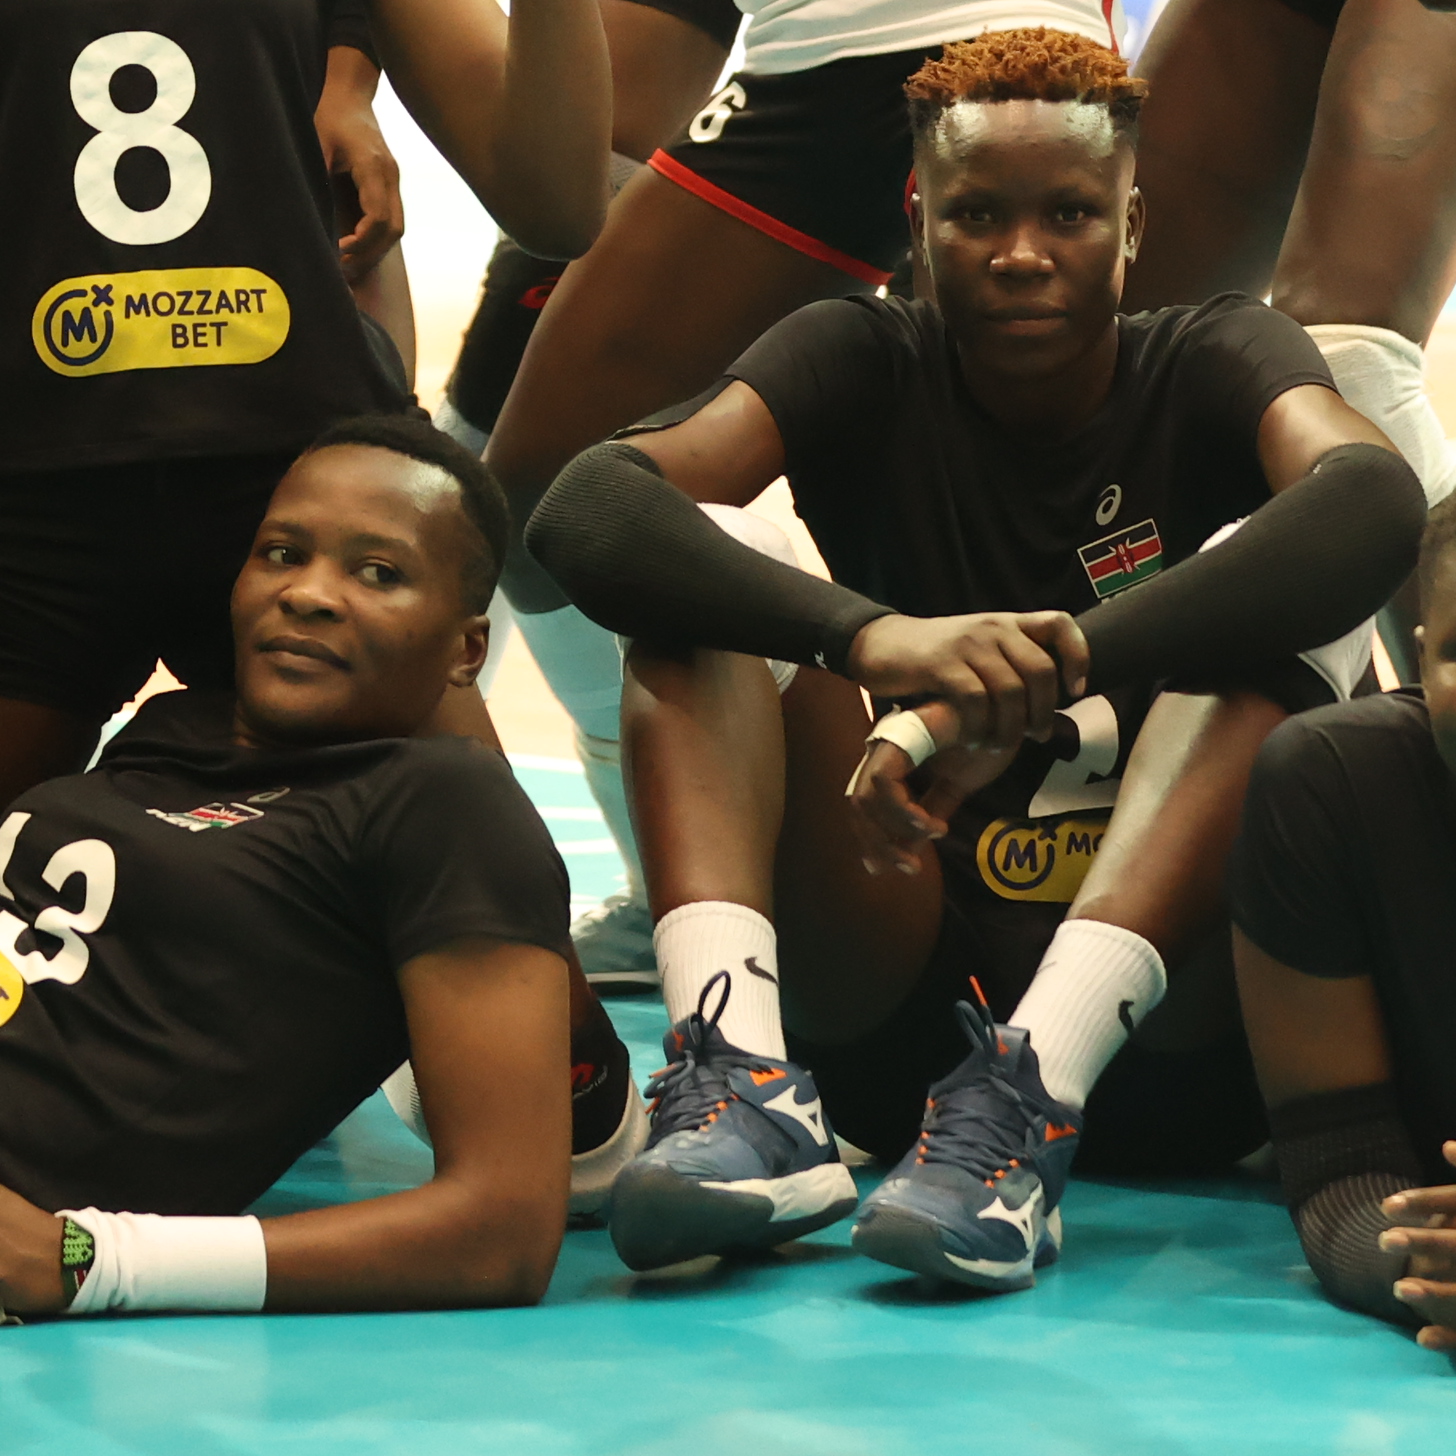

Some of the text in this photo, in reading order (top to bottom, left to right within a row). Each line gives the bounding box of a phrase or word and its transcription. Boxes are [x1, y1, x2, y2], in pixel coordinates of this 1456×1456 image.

[689, 81, 747, 143] 6
[70, 31, 212, 245] 8
[124, 288, 268, 319] MOZZART
[171, 321, 229, 349] BET
